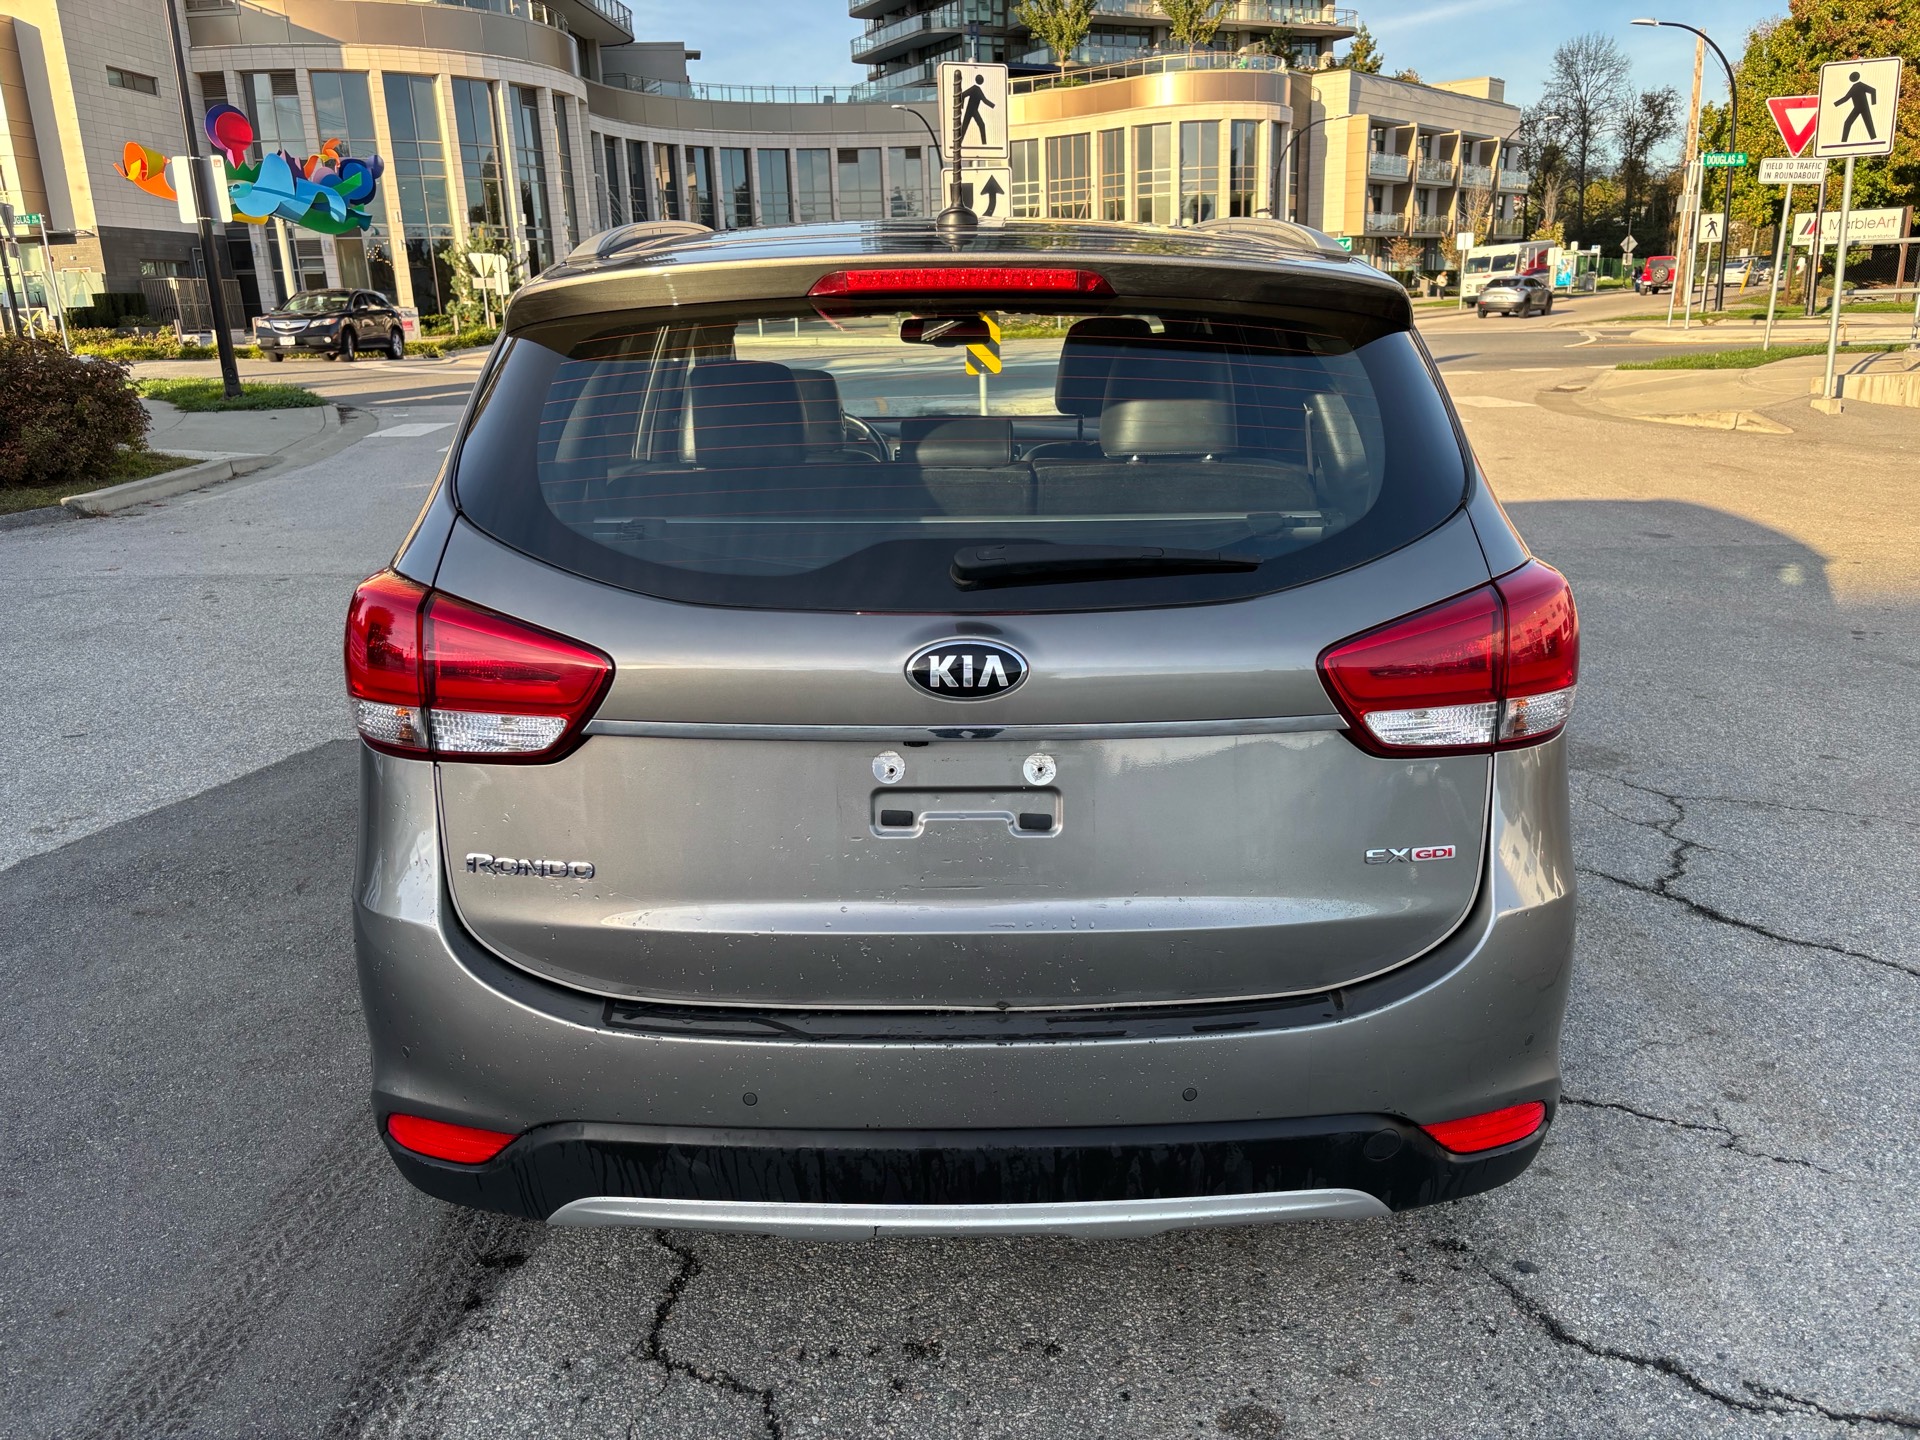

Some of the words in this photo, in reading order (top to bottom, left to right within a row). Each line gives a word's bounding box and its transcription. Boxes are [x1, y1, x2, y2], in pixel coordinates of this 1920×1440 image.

[1706, 154, 1736, 165] DOUGLAS
[1765, 162, 1783, 170] YIELD
[1786, 162, 1794, 170] TO
[1796, 162, 1822, 170] TRAFFIC
[1764, 171, 1771, 179] IN
[1774, 171, 1821, 179] ROUNDABOUT
[13, 215, 31, 225] UGLAS
[928, 655, 1009, 688] KIA
[1365, 847, 1410, 865] EX
[1415, 847, 1453, 859] GDI
[465, 852, 595, 880] RONDO
